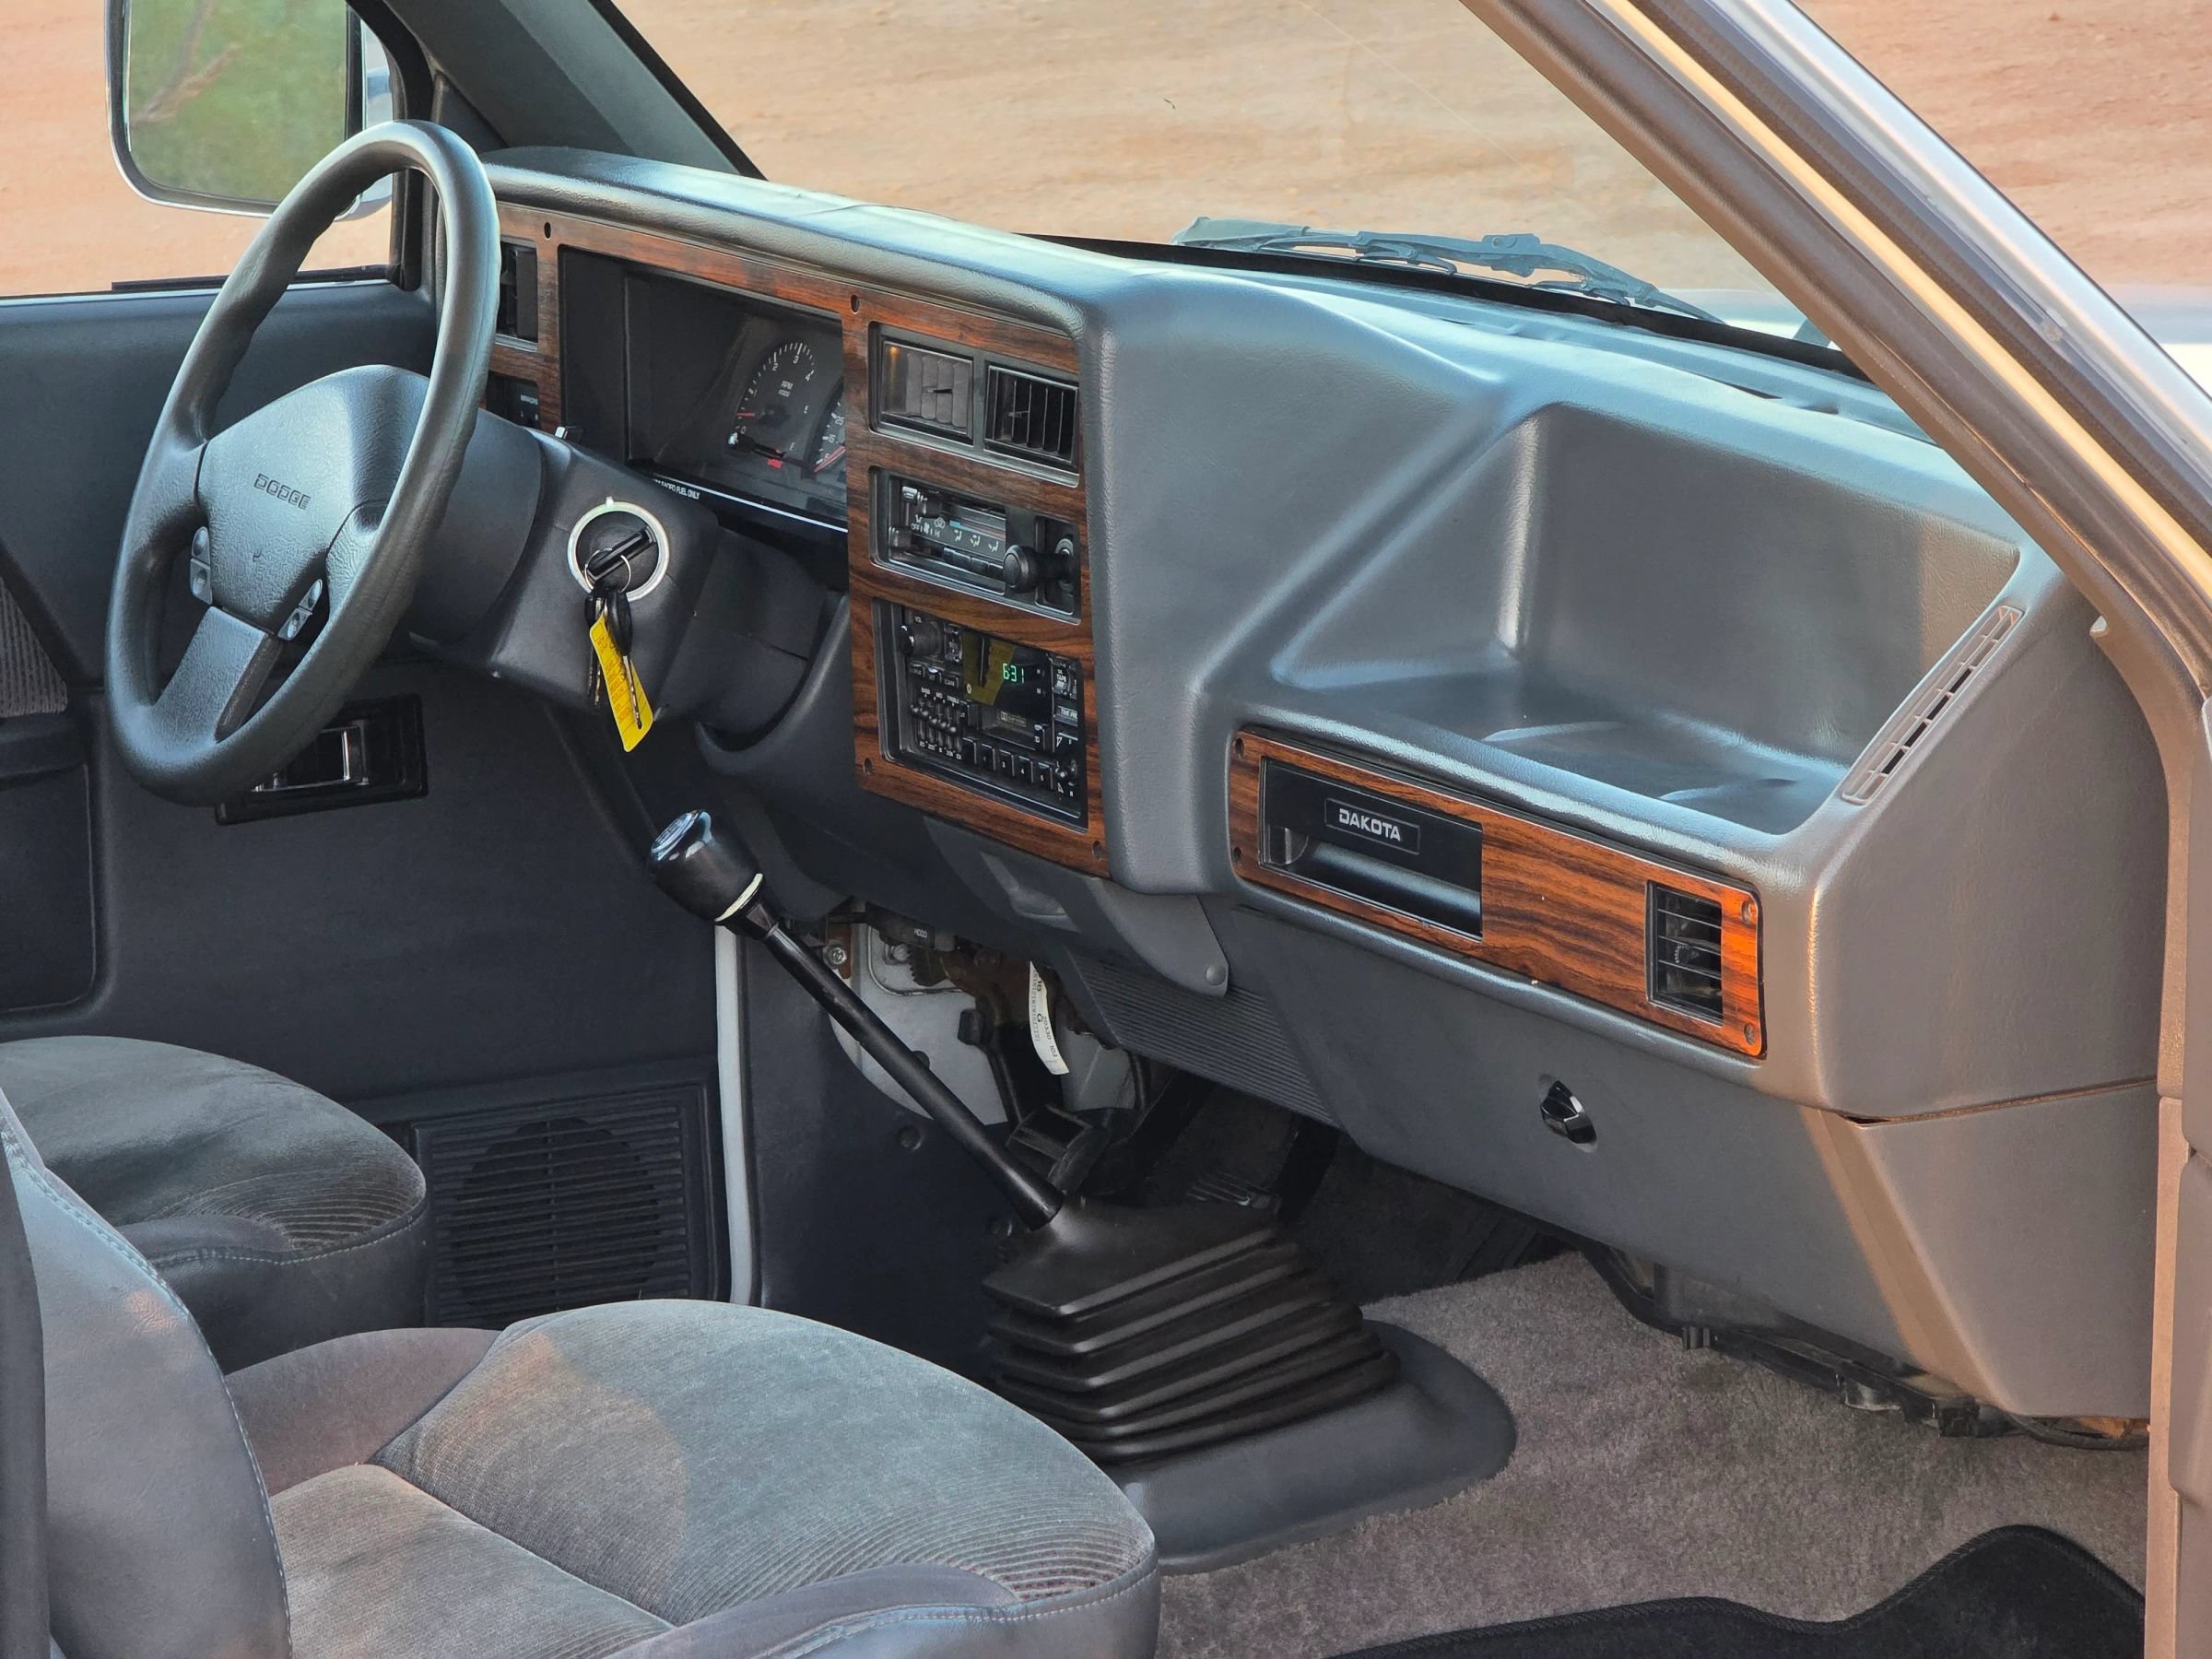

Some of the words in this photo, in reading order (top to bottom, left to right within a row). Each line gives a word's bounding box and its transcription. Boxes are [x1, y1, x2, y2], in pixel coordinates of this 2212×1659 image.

[793, 355, 799, 364] 3
[772, 363, 779, 371] 2
[781, 380, 793, 390] RPM
[253, 473, 311, 511] DODGE
[676, 486, 688, 496] FUEL
[1002, 663, 1025, 684] 6:31
[1338, 807, 1402, 841] DAKOTA
